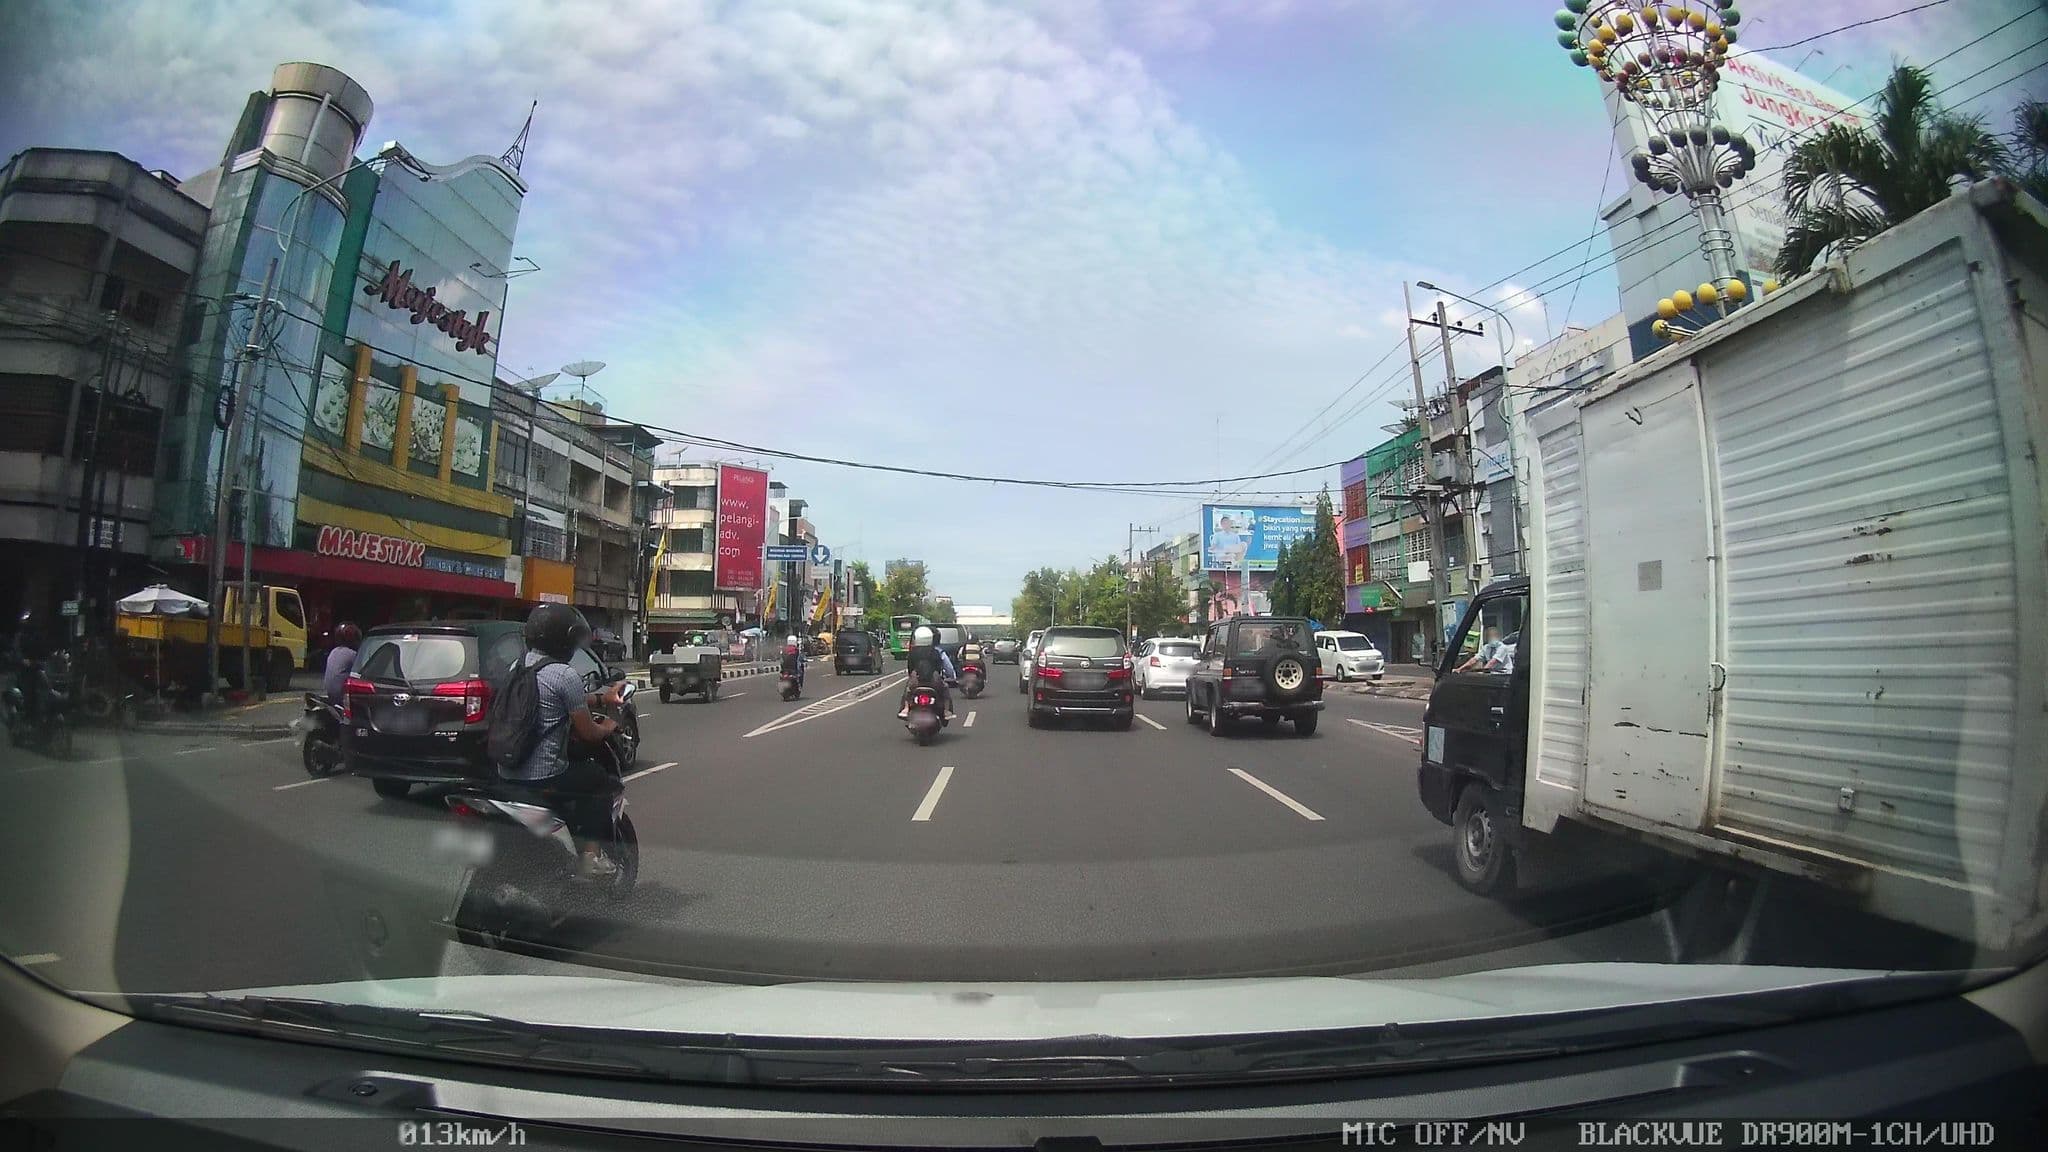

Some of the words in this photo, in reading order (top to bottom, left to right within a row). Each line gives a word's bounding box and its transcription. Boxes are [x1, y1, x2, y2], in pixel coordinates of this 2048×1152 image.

[1740, 83, 1815, 127] Jungkir
[720, 497, 749, 509] www.
[720, 529, 740, 540] adv.
[318, 525, 425, 567] MAJESTYK
[719, 546, 740, 557] com
